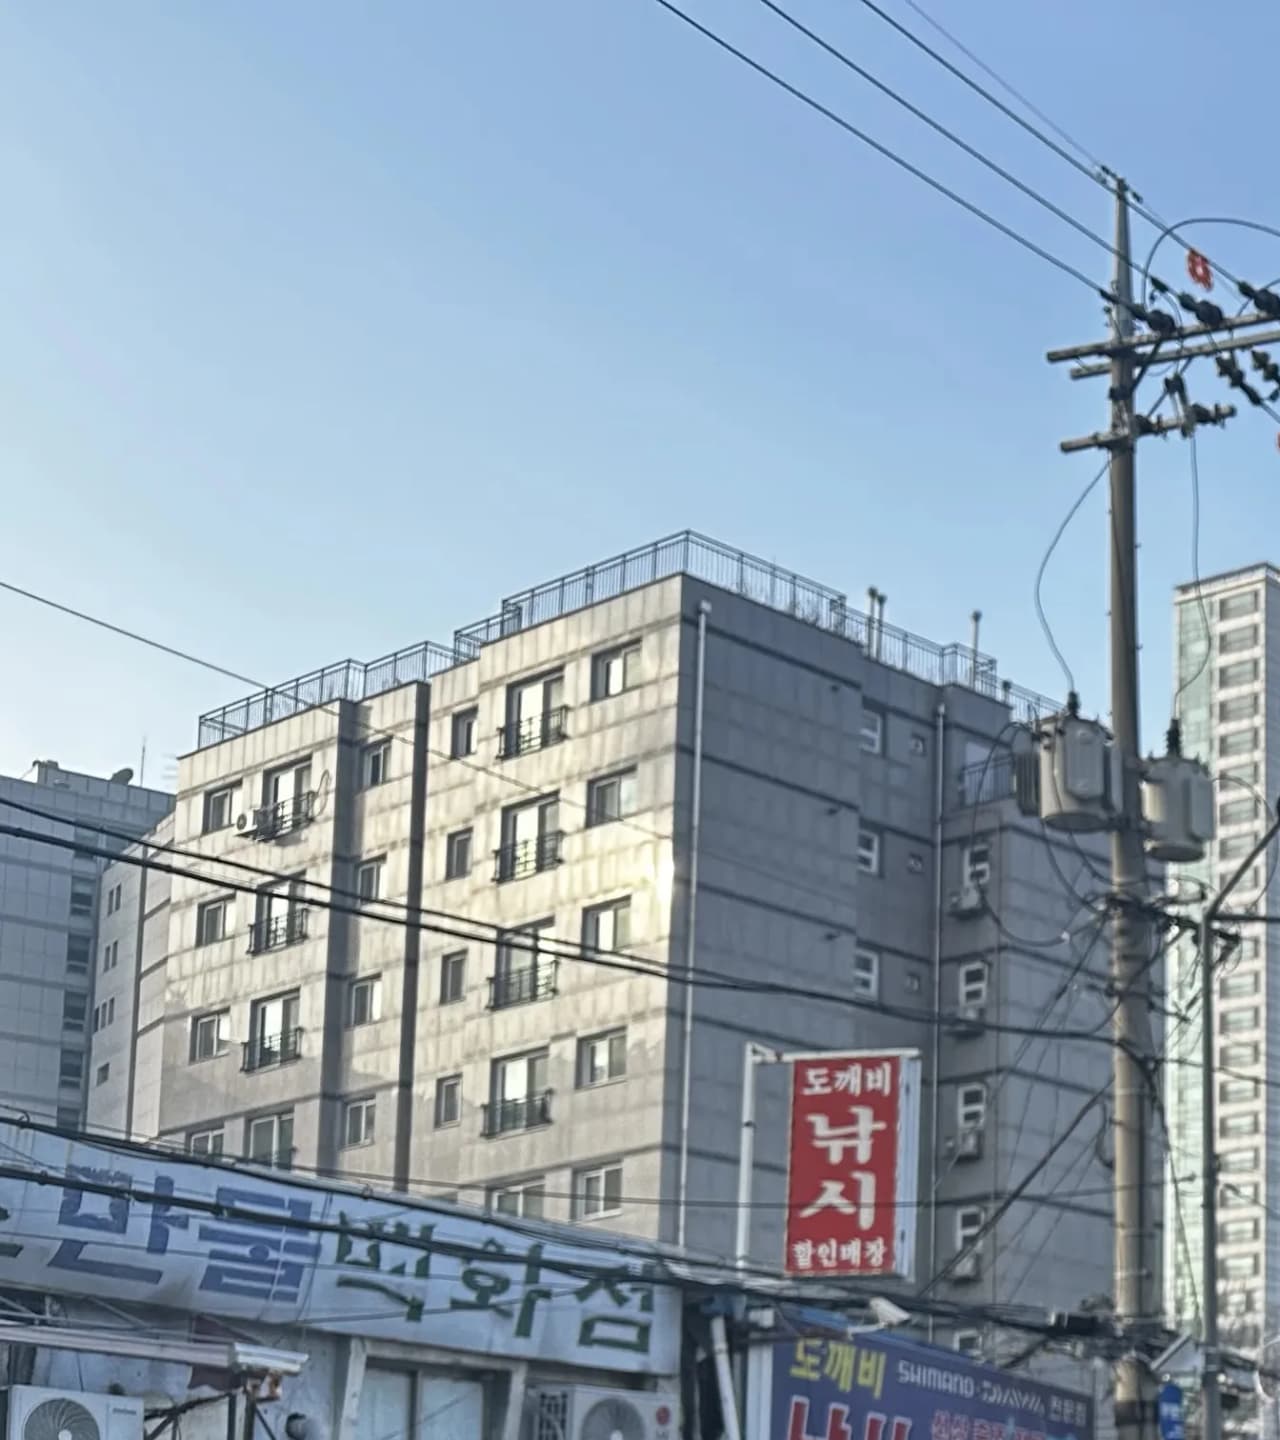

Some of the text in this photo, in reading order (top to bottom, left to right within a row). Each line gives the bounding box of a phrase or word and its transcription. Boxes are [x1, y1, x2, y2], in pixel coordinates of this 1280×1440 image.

[803, 1061, 892, 1096] 도깨비
[800, 1105, 887, 1231] 낚시
[47, 1163, 656, 1353] 만물 백화점
[793, 1237, 887, 1270] 할인매장
[790, 1338, 887, 1400] 도깨비
[898, 1360, 974, 1399] SHIMANO
